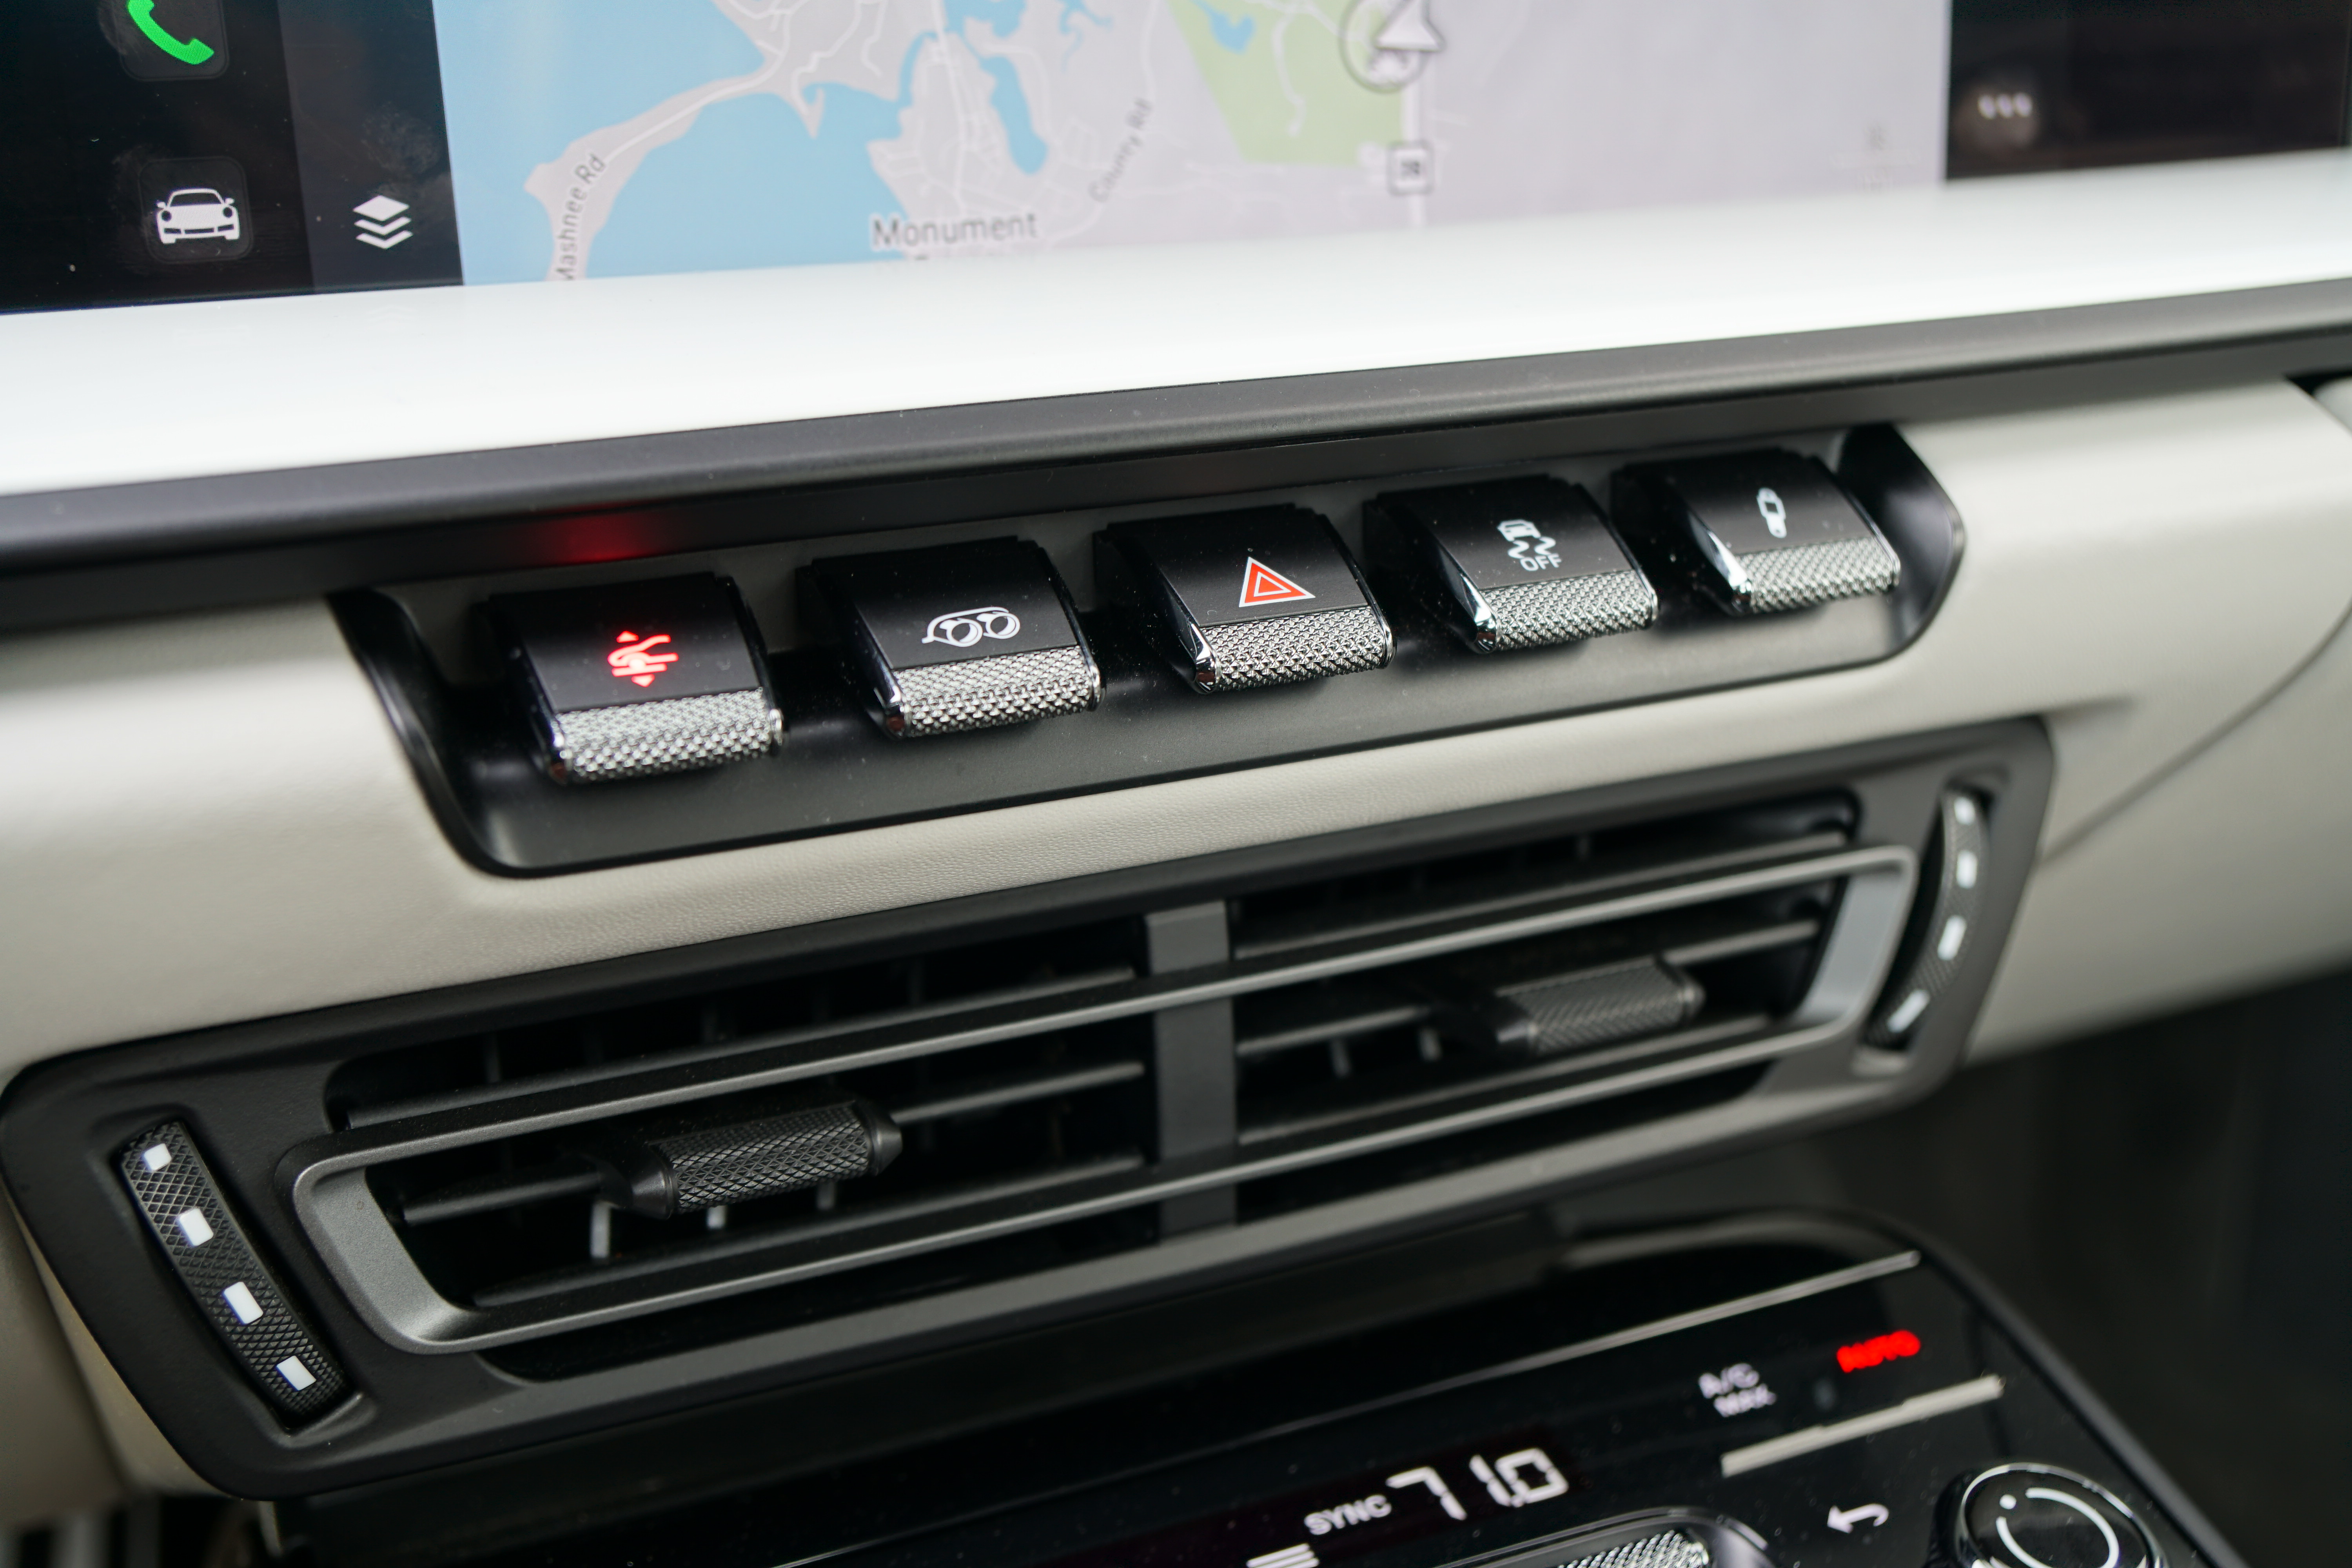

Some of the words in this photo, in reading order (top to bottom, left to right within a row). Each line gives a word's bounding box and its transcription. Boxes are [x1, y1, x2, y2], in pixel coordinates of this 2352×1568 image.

[575, 154, 606, 184] Rd
[873, 213, 1038, 247] Monument
[1520, 553, 1561, 571] OFF
[1303, 1494, 1393, 1535] SYNC
